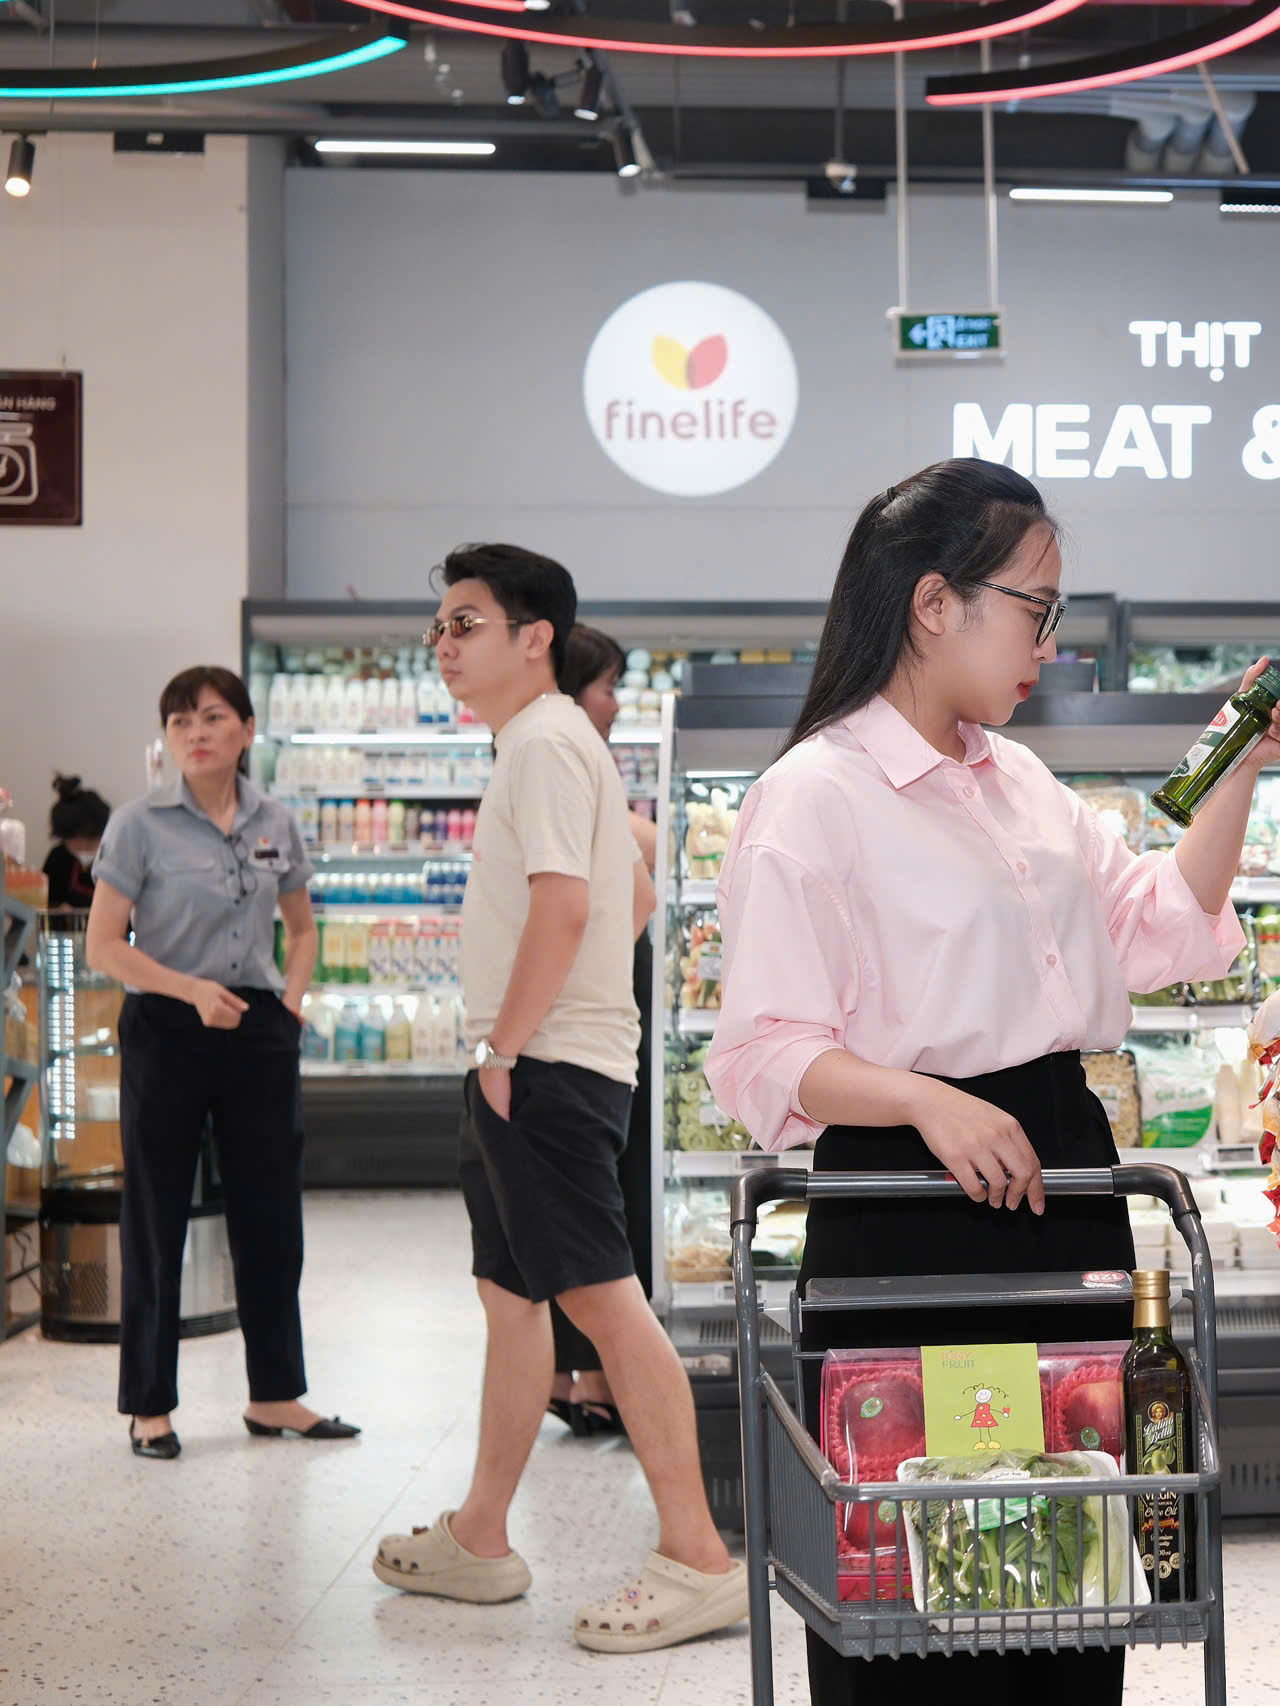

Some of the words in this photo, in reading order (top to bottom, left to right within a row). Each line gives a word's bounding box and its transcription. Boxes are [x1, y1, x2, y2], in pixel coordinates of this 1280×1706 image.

[1129, 320, 1262, 382] THỊT
[605, 399, 777, 440] finelife
[953, 402, 1213, 480] MEAT
[1145, 1491, 1177, 1500] VIGIN
